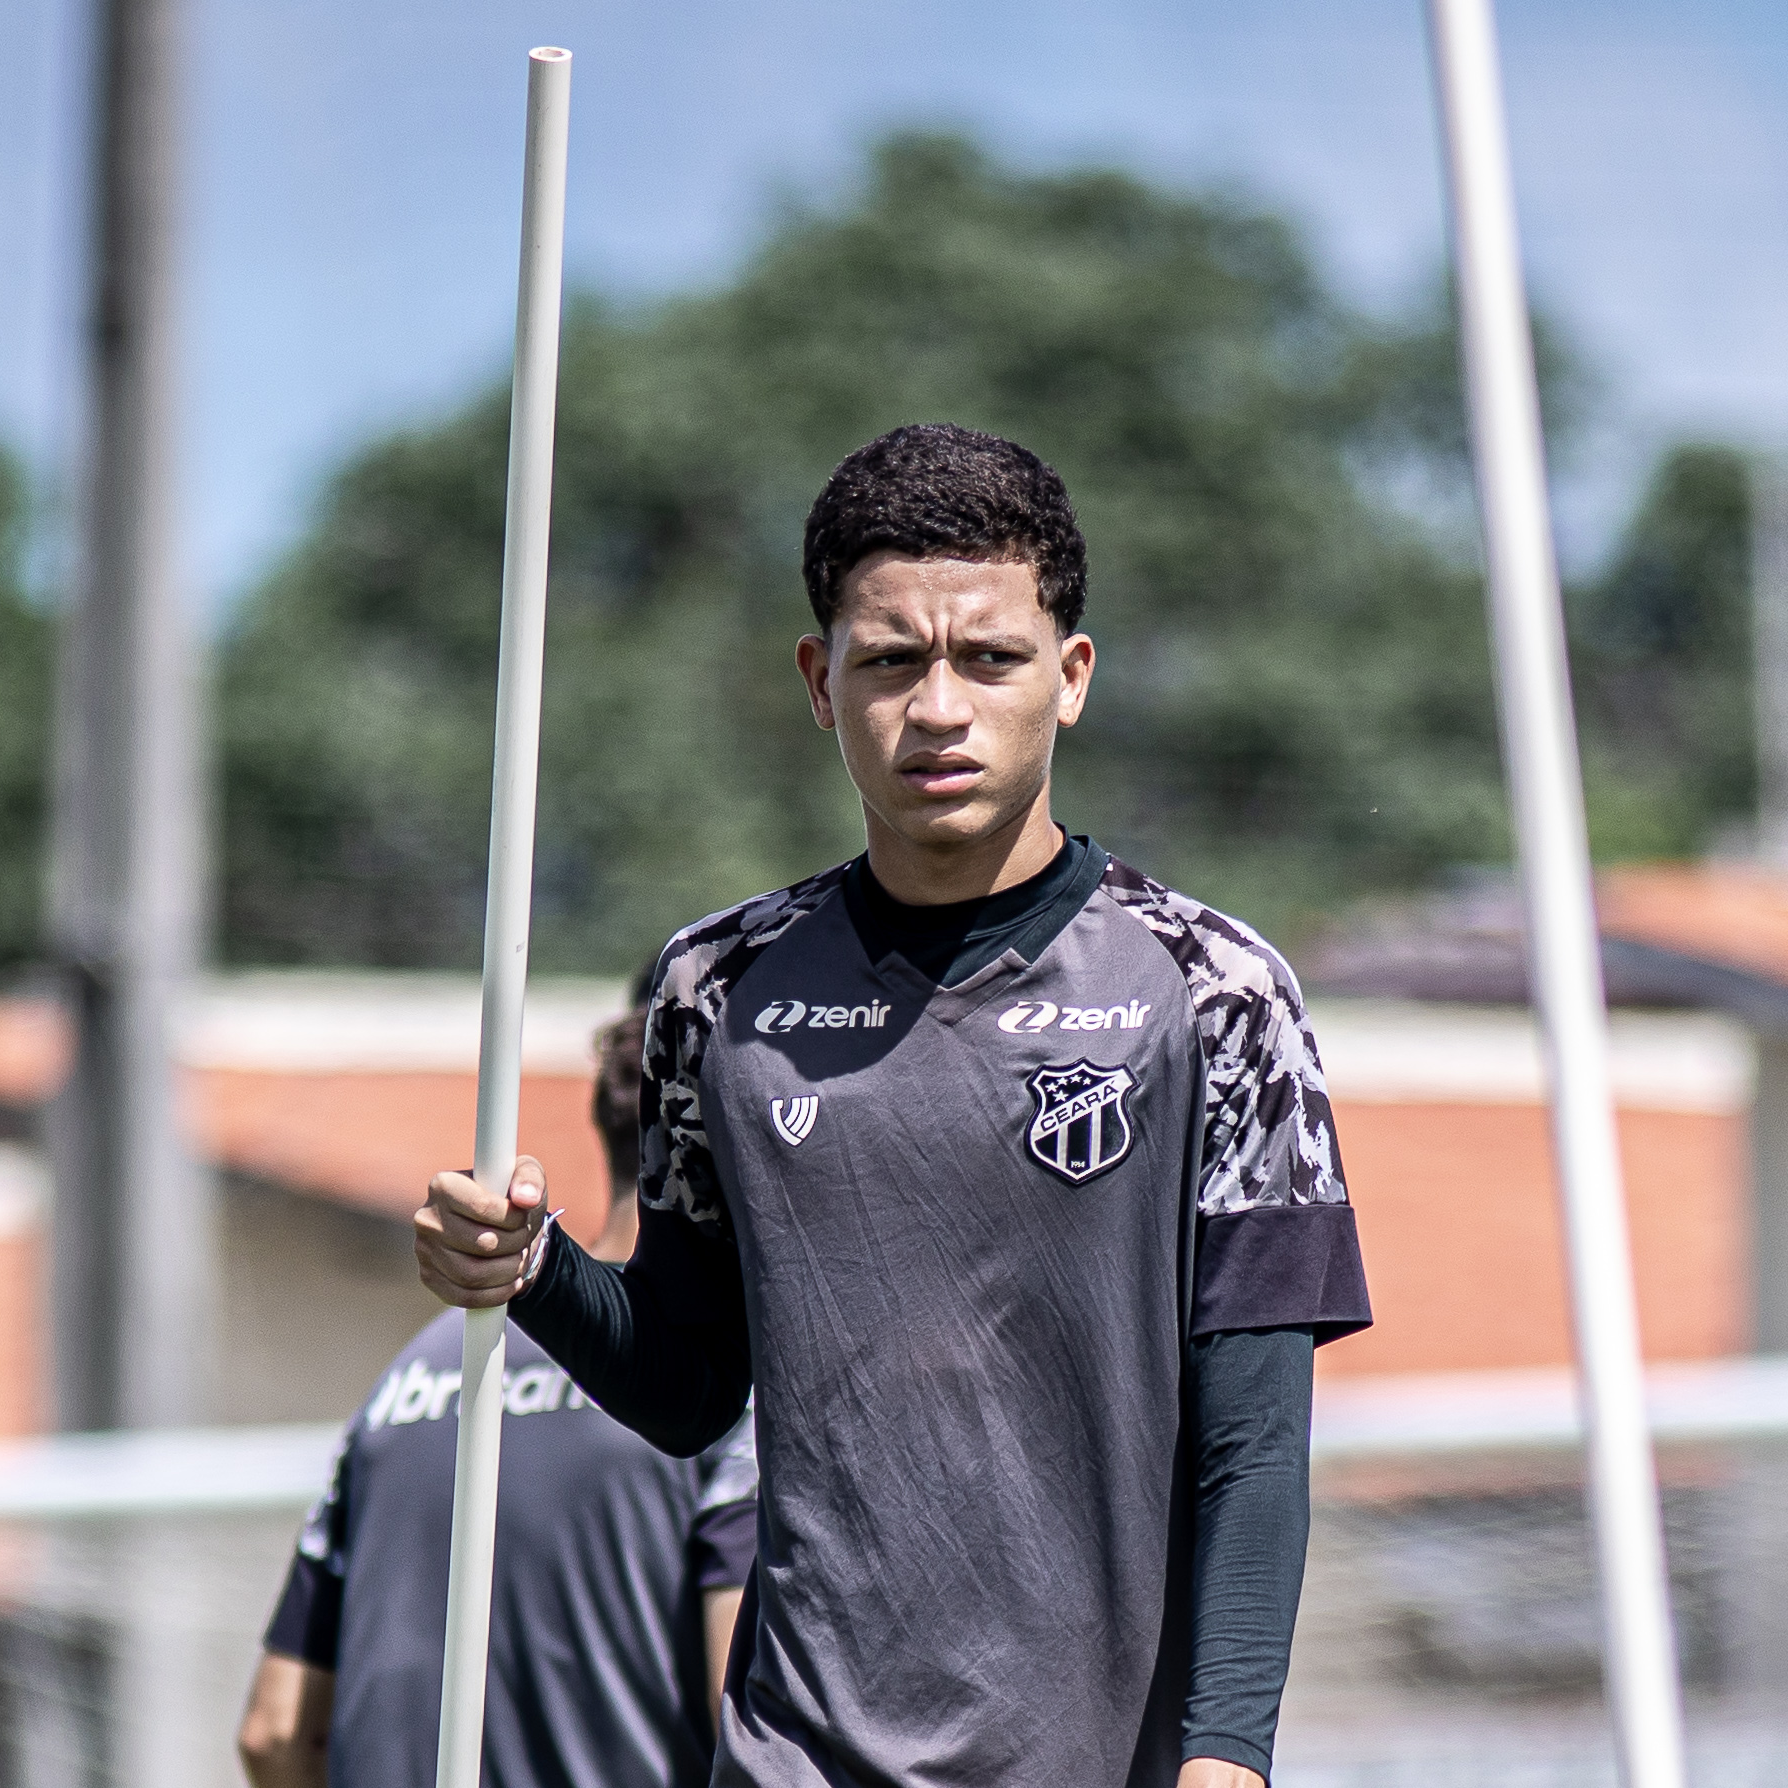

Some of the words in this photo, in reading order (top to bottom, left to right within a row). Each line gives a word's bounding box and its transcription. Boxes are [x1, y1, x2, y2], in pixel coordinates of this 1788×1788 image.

[808, 998, 892, 1028] zenir
[1059, 998, 1152, 1031] zenir
[1039, 1079, 1120, 1132] CEARÁ
